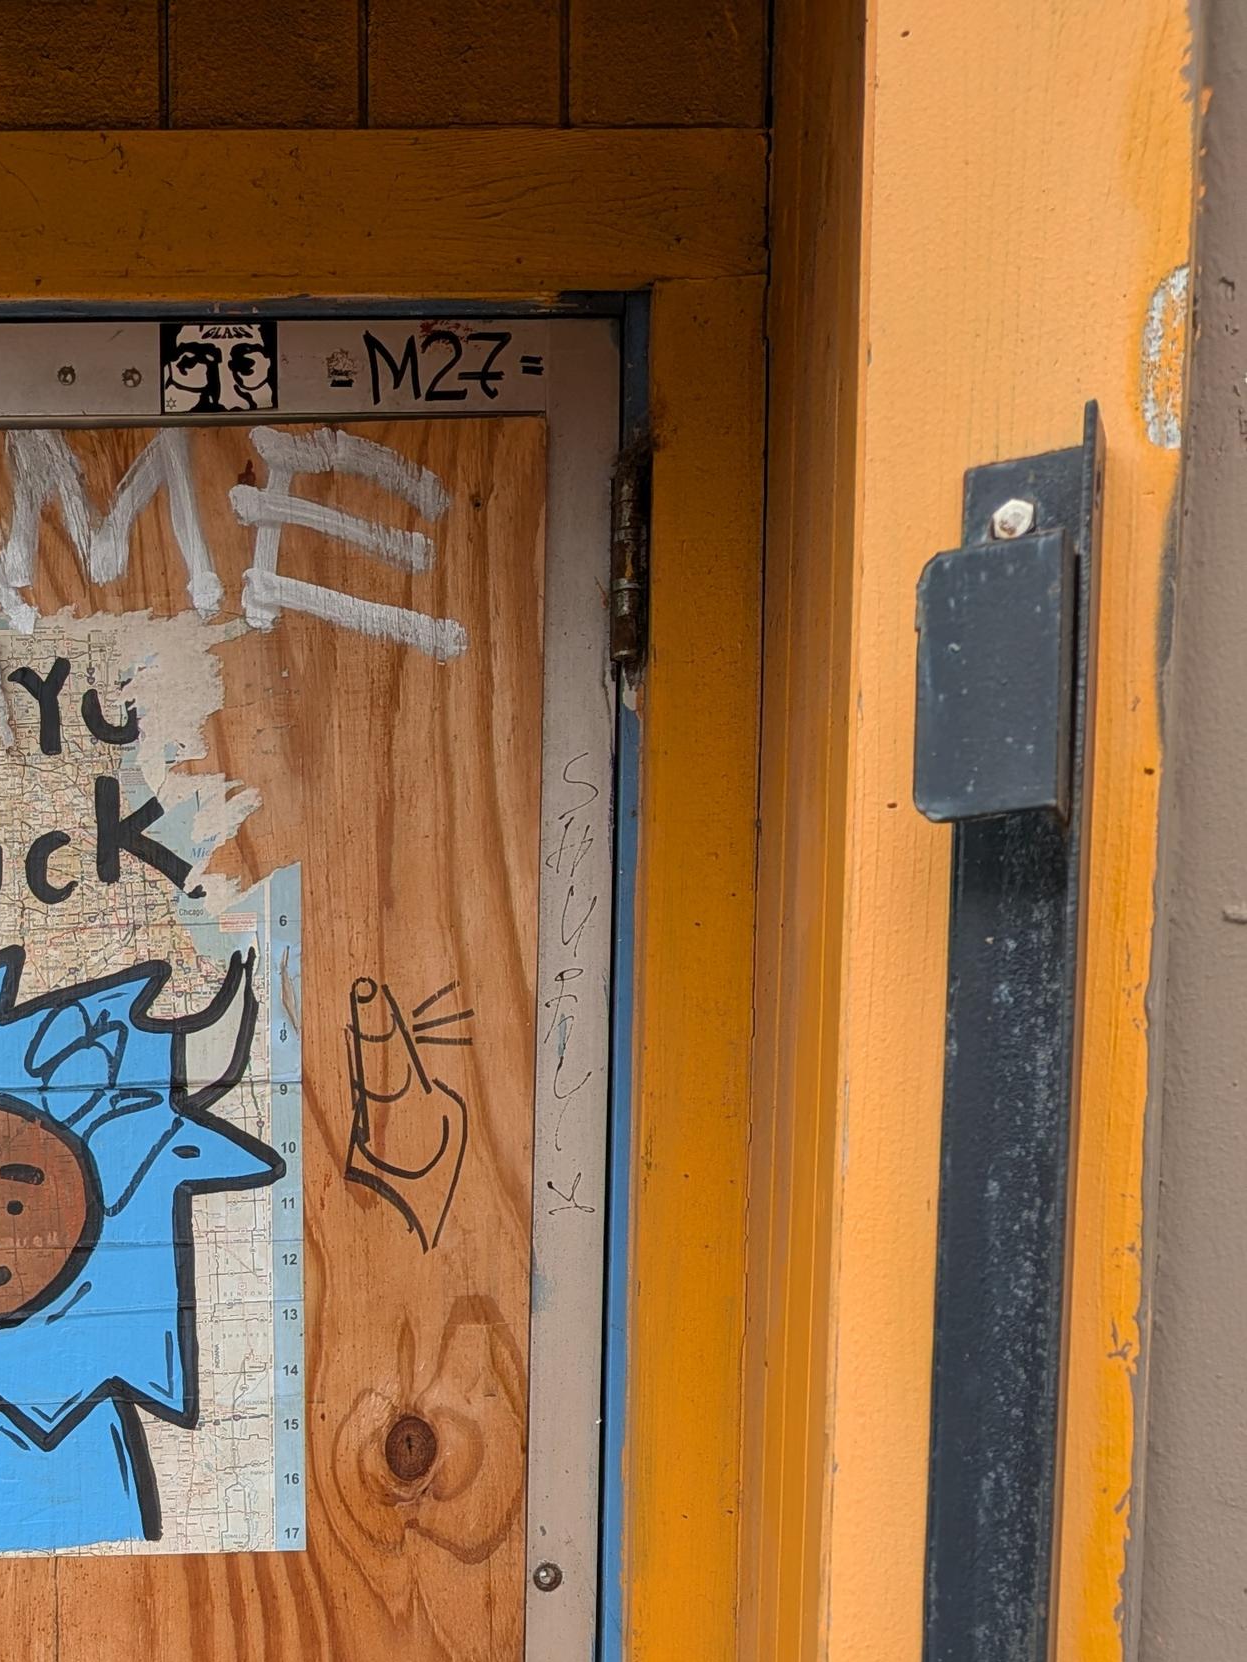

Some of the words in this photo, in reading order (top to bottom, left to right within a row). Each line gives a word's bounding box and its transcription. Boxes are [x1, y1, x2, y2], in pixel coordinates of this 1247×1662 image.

[201, 326, 254, 340] GLASS
[179, 908, 204, 917] Chicago
[279, 914, 288, 927] 6
[279, 1083, 288, 1095] 9
[281, 1141, 297, 1154] 10
[281, 1197, 295, 1209] 11
[282, 1254, 298, 1266] 12
[282, 1309, 298, 1321] 13
[283, 1365, 299, 1376] 14
[283, 1419, 299, 1430] 15
[284, 1473, 300, 1484] 16
[284, 1528, 300, 1539] 17
